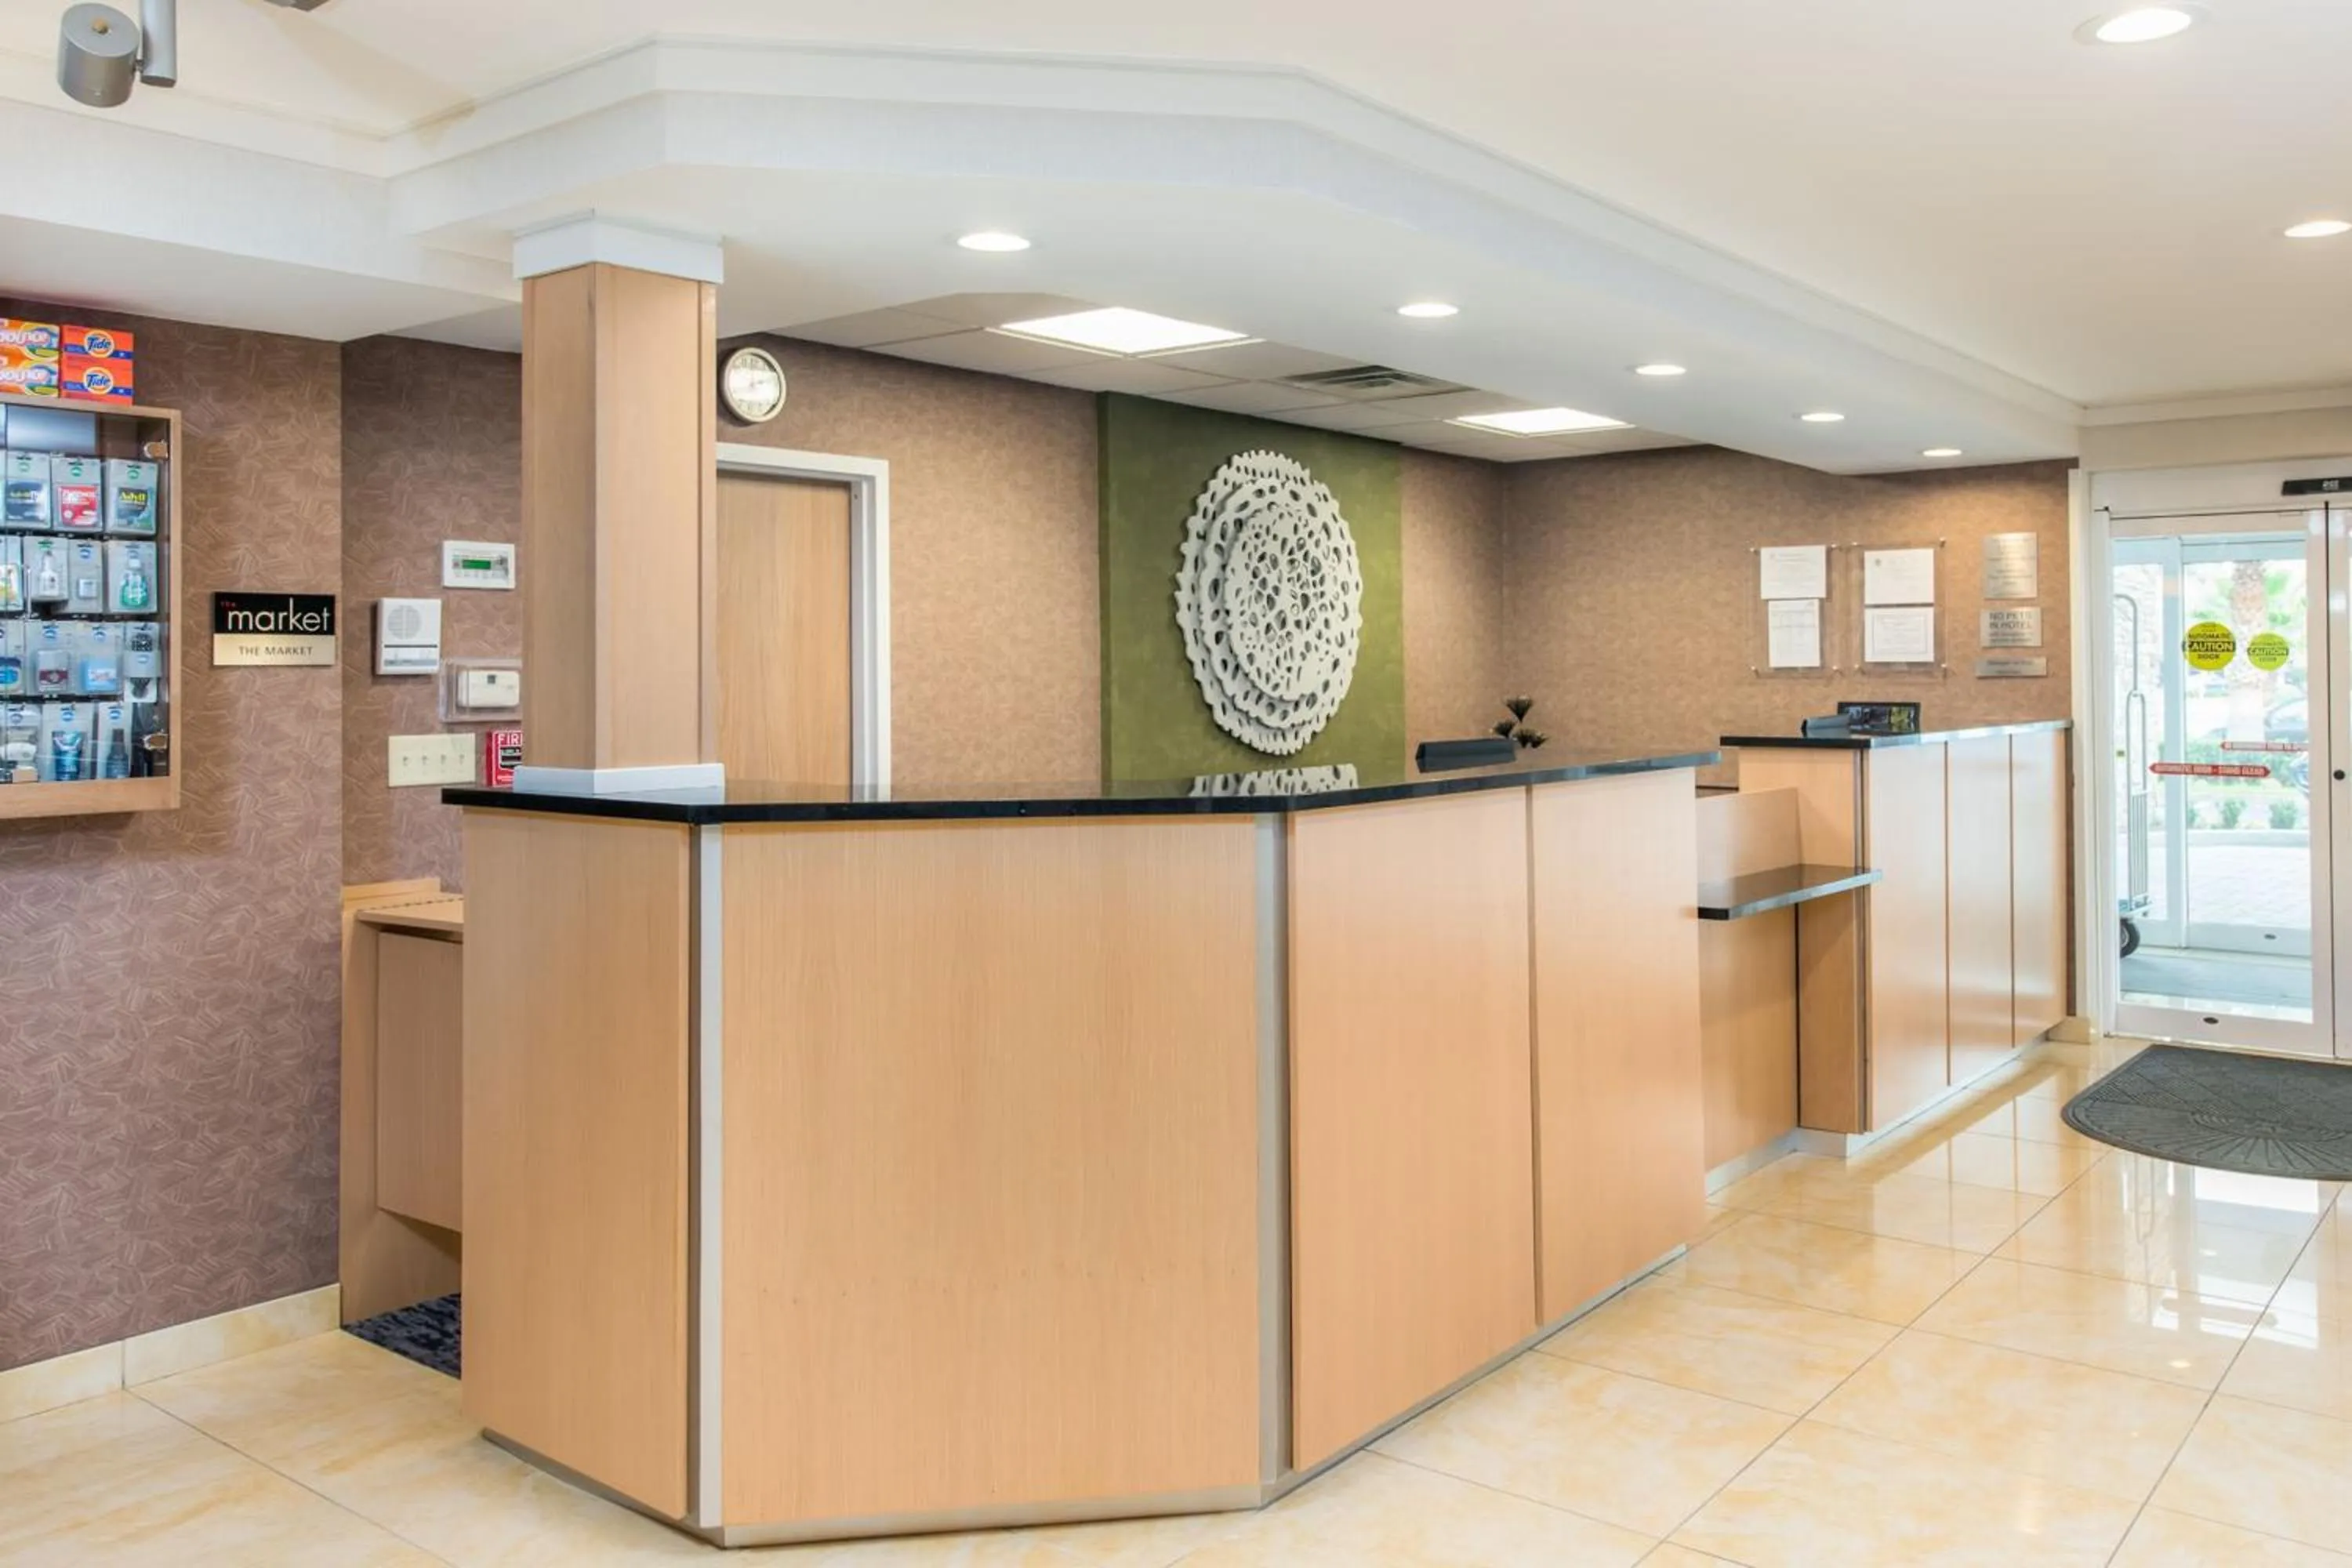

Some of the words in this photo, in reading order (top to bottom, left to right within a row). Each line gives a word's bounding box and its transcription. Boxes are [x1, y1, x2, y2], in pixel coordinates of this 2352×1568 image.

[86, 336, 111, 350] Tide
[86, 373, 111, 387] Tide
[228, 597, 331, 632] market
[238, 646, 261, 656] THE
[264, 646, 313, 656] MARKET
[2185, 642, 2234, 652] CAUTION
[498, 732, 523, 745] FIR
